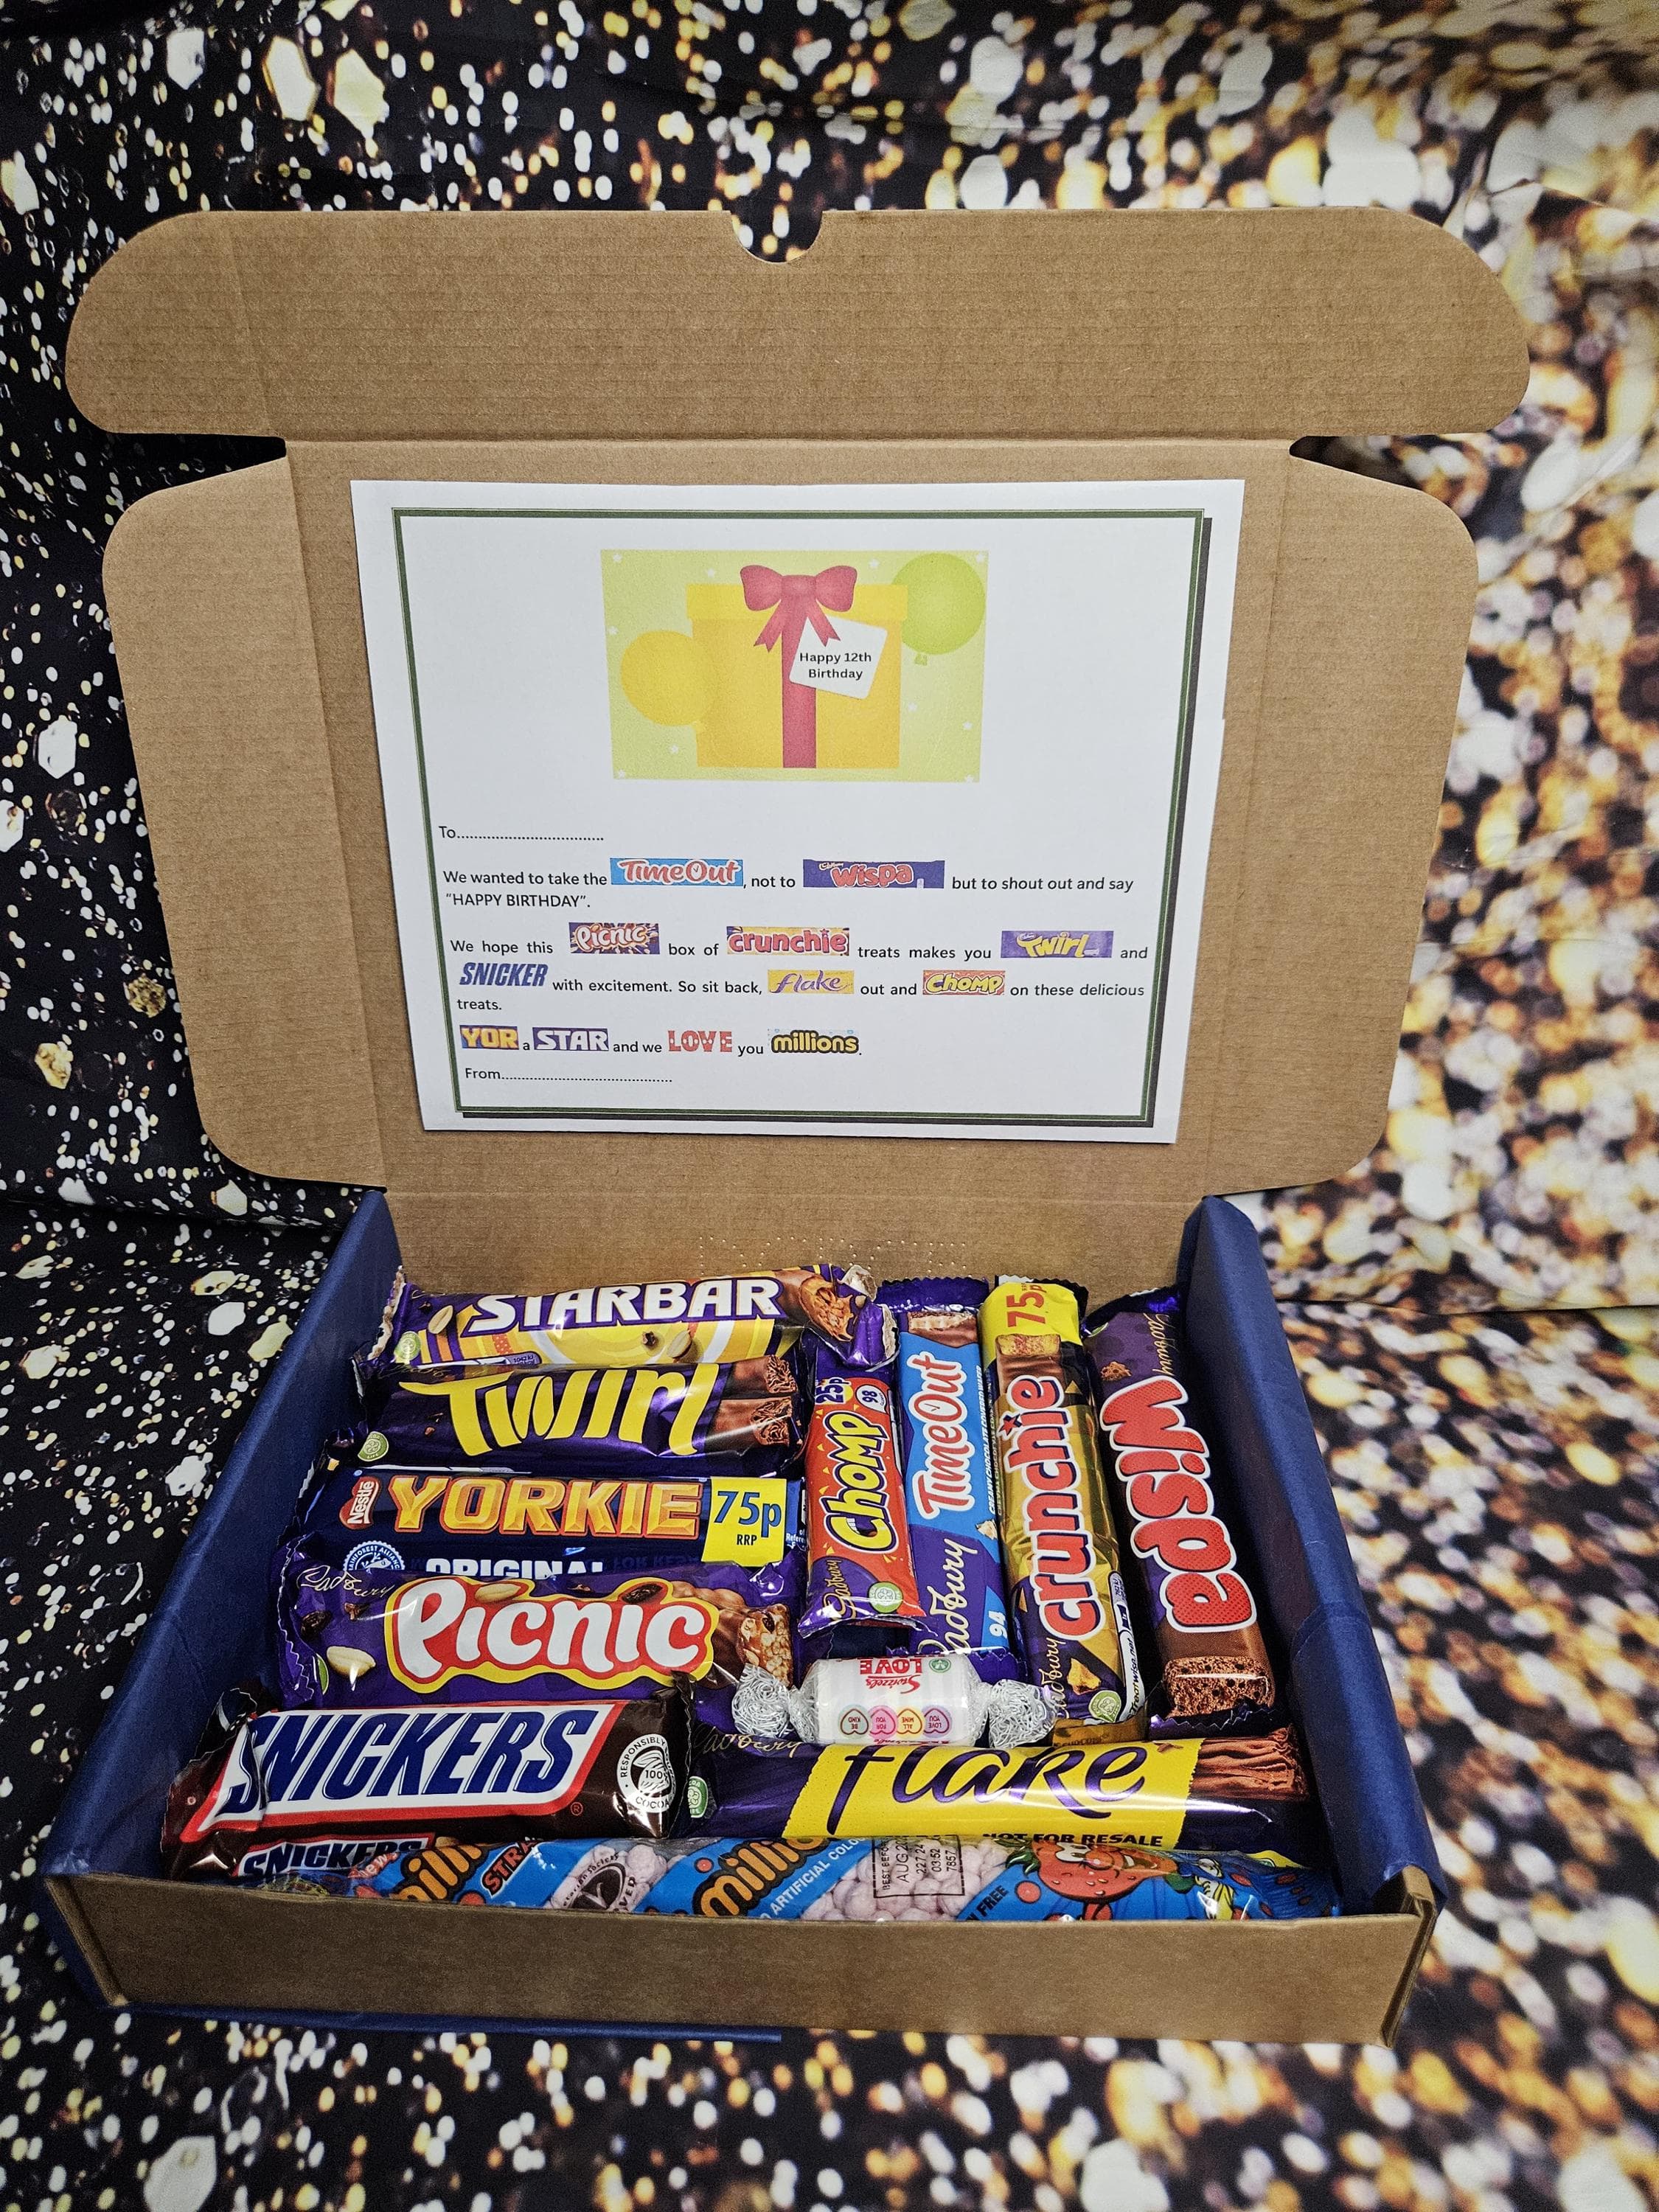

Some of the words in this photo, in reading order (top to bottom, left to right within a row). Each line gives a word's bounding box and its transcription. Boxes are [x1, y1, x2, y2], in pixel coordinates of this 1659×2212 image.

[799, 652, 841, 665] Happy
[844, 651, 872, 662] 12th
[808, 668, 863, 681] Birthday
[442, 870, 467, 883] We
[470, 871, 525, 885] wanted
[527, 872, 544, 885] to
[547, 872, 582, 886] take
[585, 872, 608, 886] the
[751, 876, 776, 888] not
[779, 876, 796, 888] to
[952, 876, 977, 890] but
[981, 878, 998, 890] to
[1001, 876, 1044, 890] shout
[1047, 878, 1073, 890] out
[1077, 877, 1105, 890] and
[1108, 880, 1134, 894] say
[450, 939, 474, 953] We
[481, 939, 519, 956] hope
[526, 941, 554, 954] this
[668, 942, 695, 956] box
[703, 943, 720, 956] of
[857, 946, 900, 959] treats
[909, 945, 956, 959] makes
[964, 949, 992, 962] you
[1120, 946, 1148, 959] and
[459, 962, 549, 987] SNICKER
[552, 978, 583, 991] with
[588, 979, 672, 992] excitement.
[678, 980, 697, 992] So
[702, 980, 720, 993] sit
[725, 981, 762, 995] back,
[860, 984, 885, 995] out
[890, 983, 917, 995] and
[1009, 987, 1029, 996] on
[1034, 983, 1074, 996] these
[1079, 983, 1144, 996] delicious
[456, 998, 502, 1010] treats.
[460, 1028, 518, 1049] YOR
[522, 1042, 531, 1051] a
[534, 1029, 609, 1051] STAR
[613, 1040, 639, 1053] and
[641, 1044, 663, 1053] we
[667, 1030, 733, 1053] LOVE
[737, 1045, 764, 1057] you
[467, 1279, 781, 1332] STARBAR
[1006, 1285, 1047, 1328] 75p
[1143, 1312, 1180, 1377] Cadbury
[815, 1377, 852, 1404] 25p
[861, 1390, 879, 1404] 98
[398, 1363, 719, 1456] Twirl
[982, 1427, 993, 1478] CHOCOLATE
[387, 1476, 702, 1538] YORKIE
[986, 1477, 996, 1515] CREAMY
[714, 1491, 782, 1539] 75p
[736, 1534, 757, 1546] RRP
[296, 1565, 395, 1598] Cadbury
[822, 1559, 857, 1620] Cadbury
[397, 1578, 706, 1681] Picnic
[988, 1610, 1008, 1639] 94
[859, 1658, 922, 1675] LOVE
[865, 1674, 921, 1694] Swizzels
[216, 1710, 597, 1815] SNICKERS
[619, 1736, 666, 1778] RESPONSIBLY
[827, 1744, 1146, 1835] flake
[1032, 1833, 1075, 1844] FOR
[1081, 1833, 1164, 1848] RESALE
[895, 1853, 910, 1883] AUG
[930, 1848, 942, 1872] 03:52
[945, 1849, 957, 1871] 7857
[769, 1859, 830, 1915] ARTIFICIAL
[882, 1868, 891, 1891] BEST
[977, 1885, 1009, 1917] FREE
